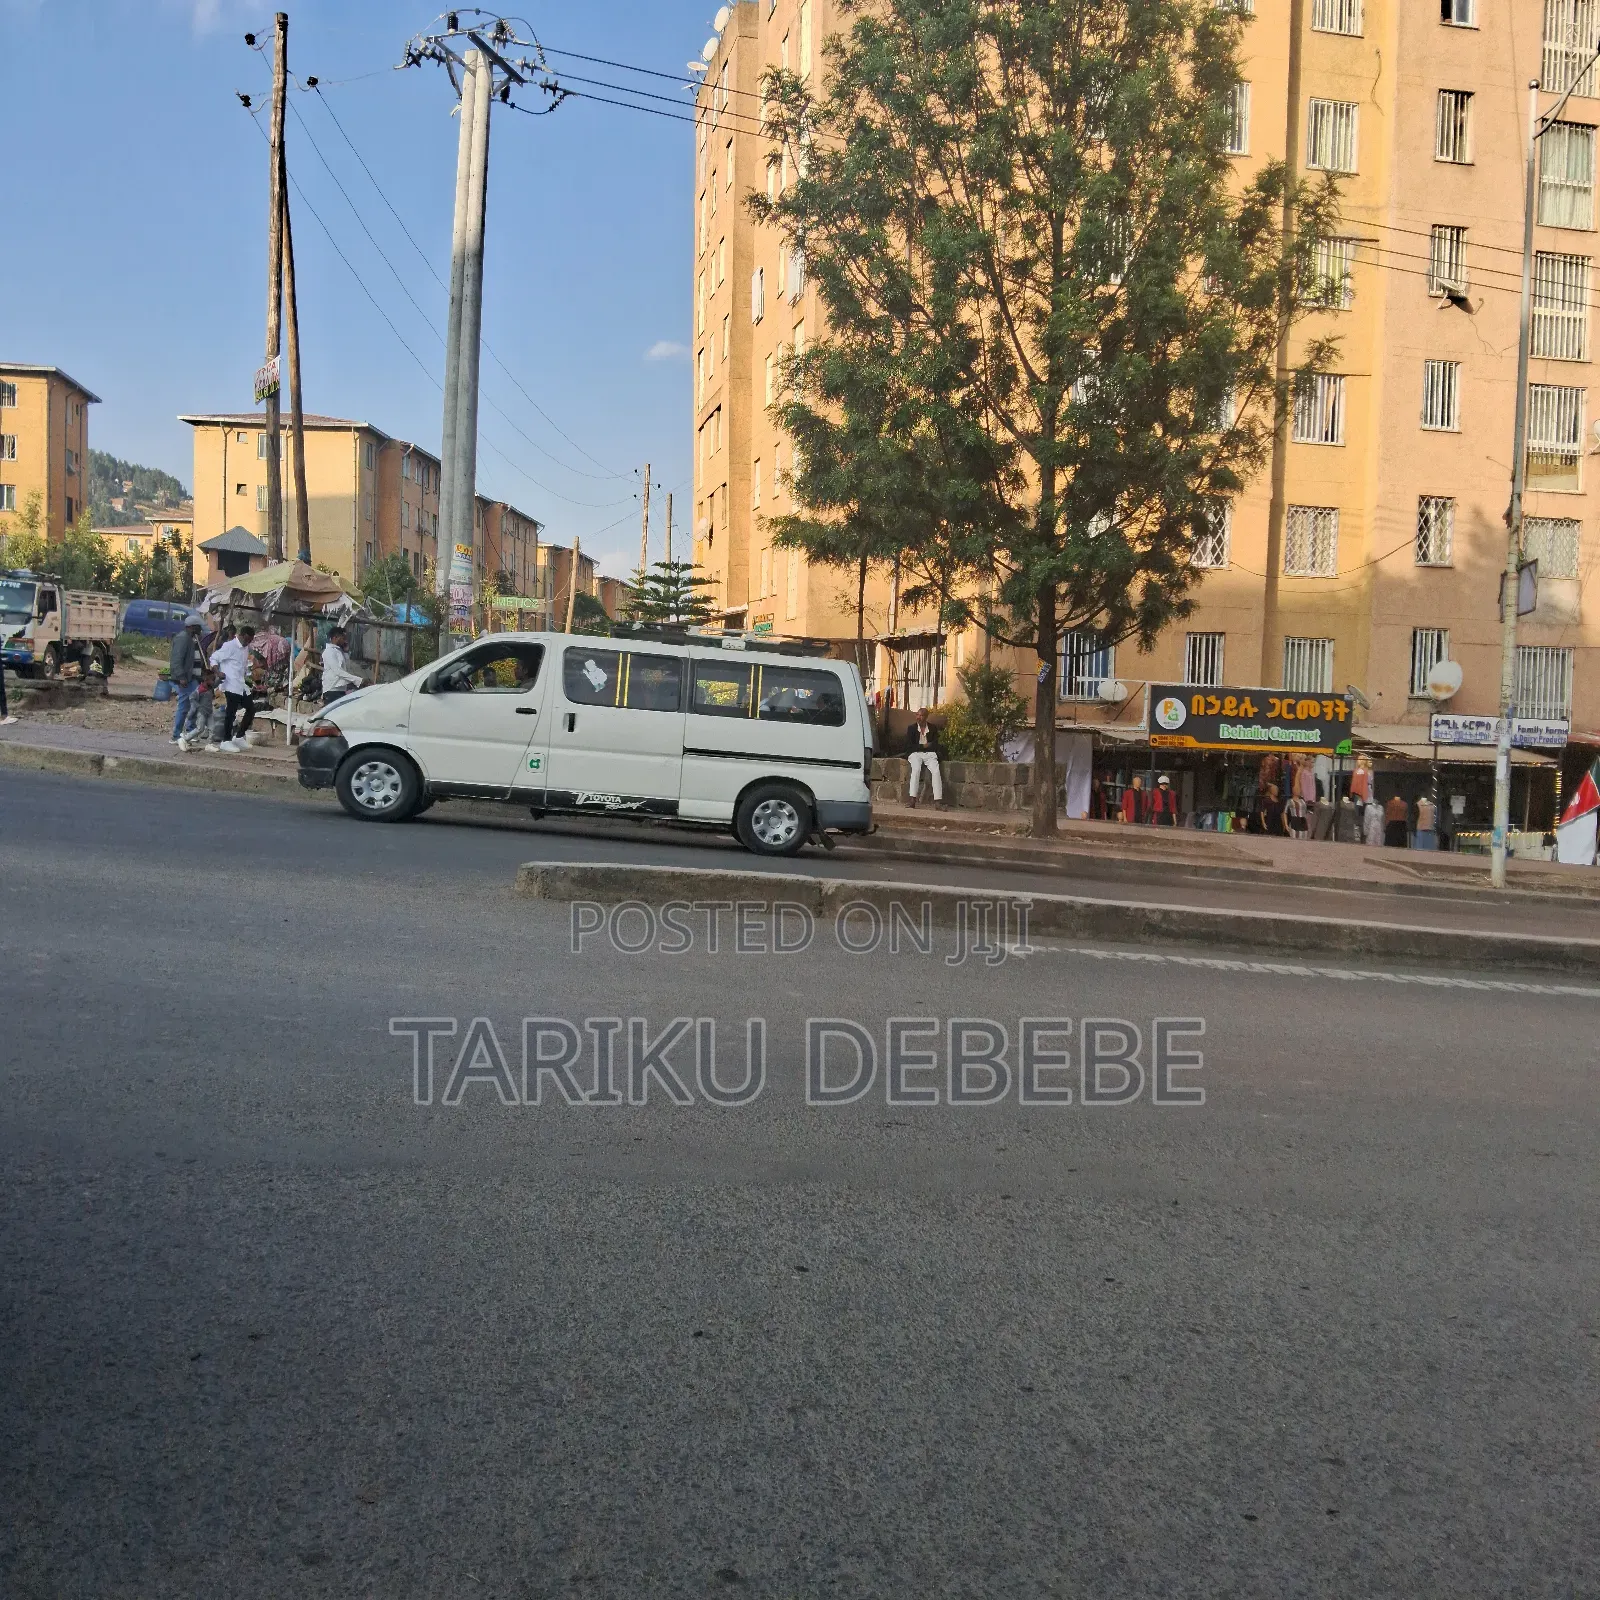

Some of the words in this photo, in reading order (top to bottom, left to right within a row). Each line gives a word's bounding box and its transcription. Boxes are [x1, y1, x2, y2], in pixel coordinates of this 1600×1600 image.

[1219, 723, 1269, 740] Behailu
[1268, 726, 1321, 742] Garmet
[1517, 725, 1544, 735] Family
[1538, 735, 1567, 744] Products
[588, 794, 621, 803] TOYOTA
